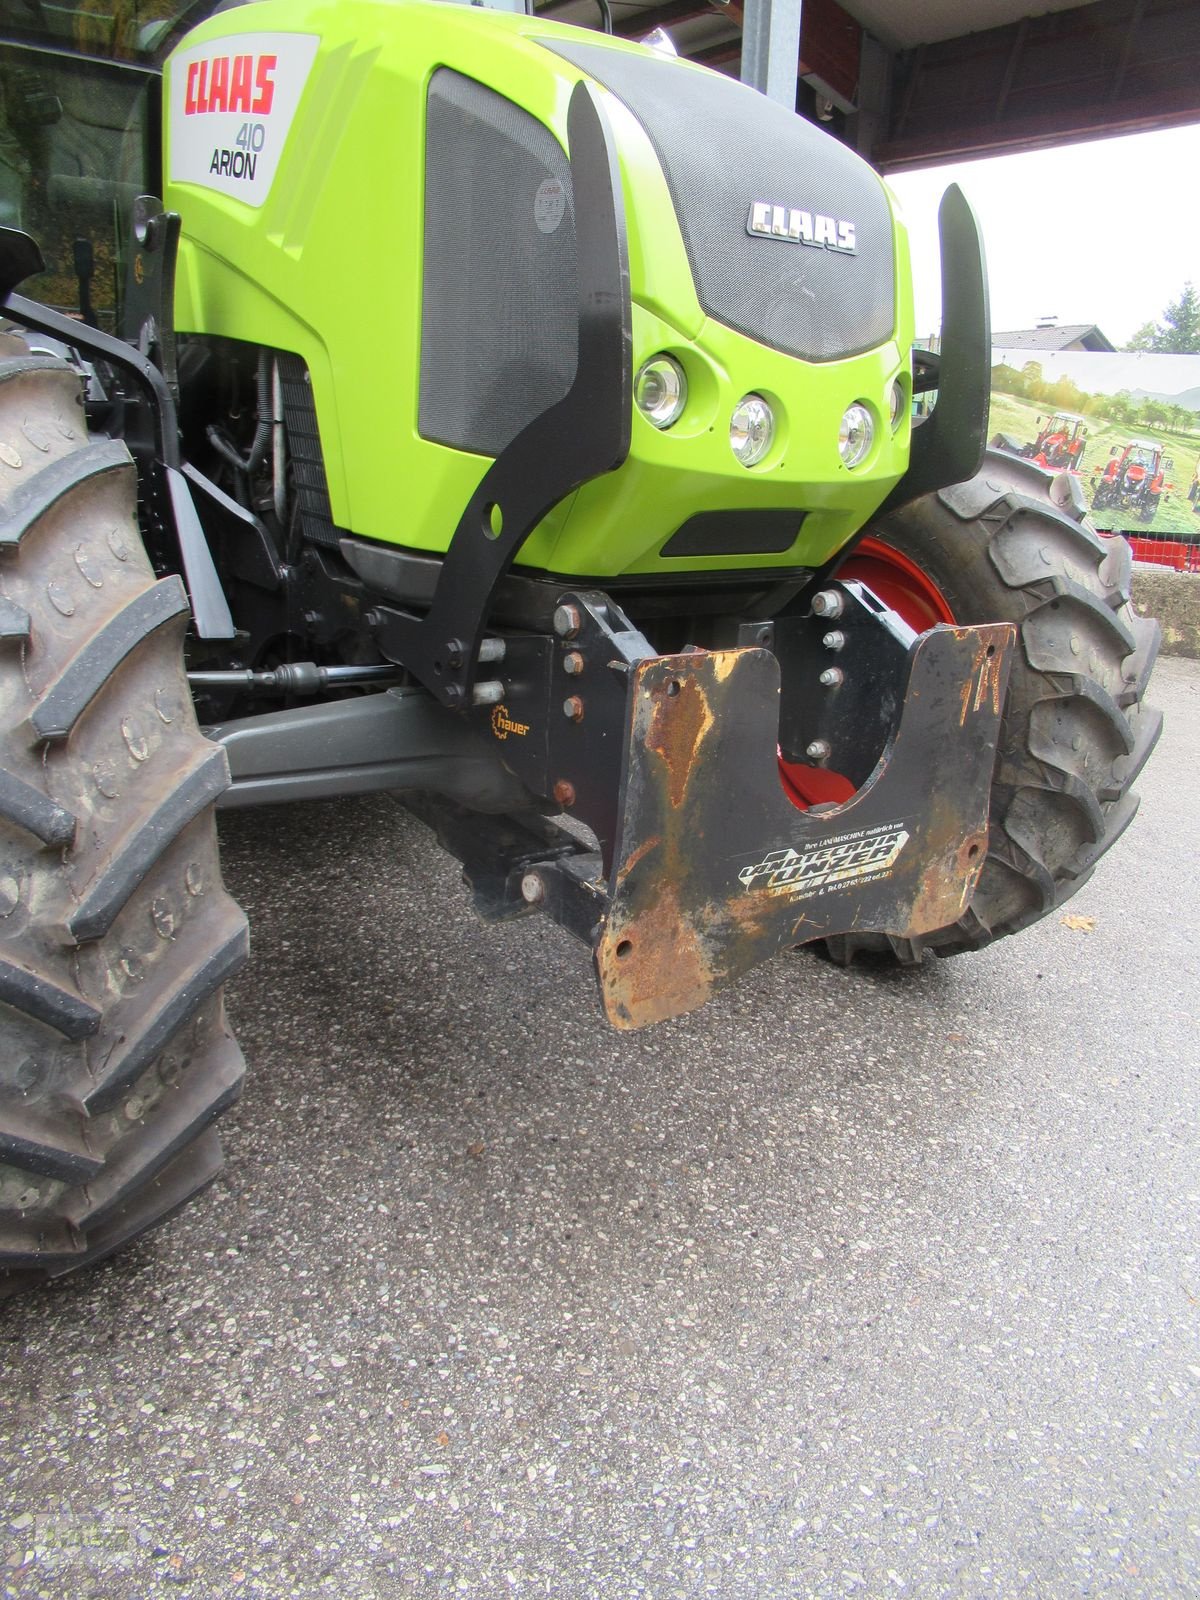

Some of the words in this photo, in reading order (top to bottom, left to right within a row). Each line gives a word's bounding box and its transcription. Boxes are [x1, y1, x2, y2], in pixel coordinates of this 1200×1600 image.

[185, 55, 278, 116] CLAAS
[235, 123, 266, 153] 410
[209, 148, 258, 181] ARION
[751, 201, 857, 252] CLAAS
[497, 712, 530, 736] hauer
[738, 832, 899, 879] LANDTECHNIK
